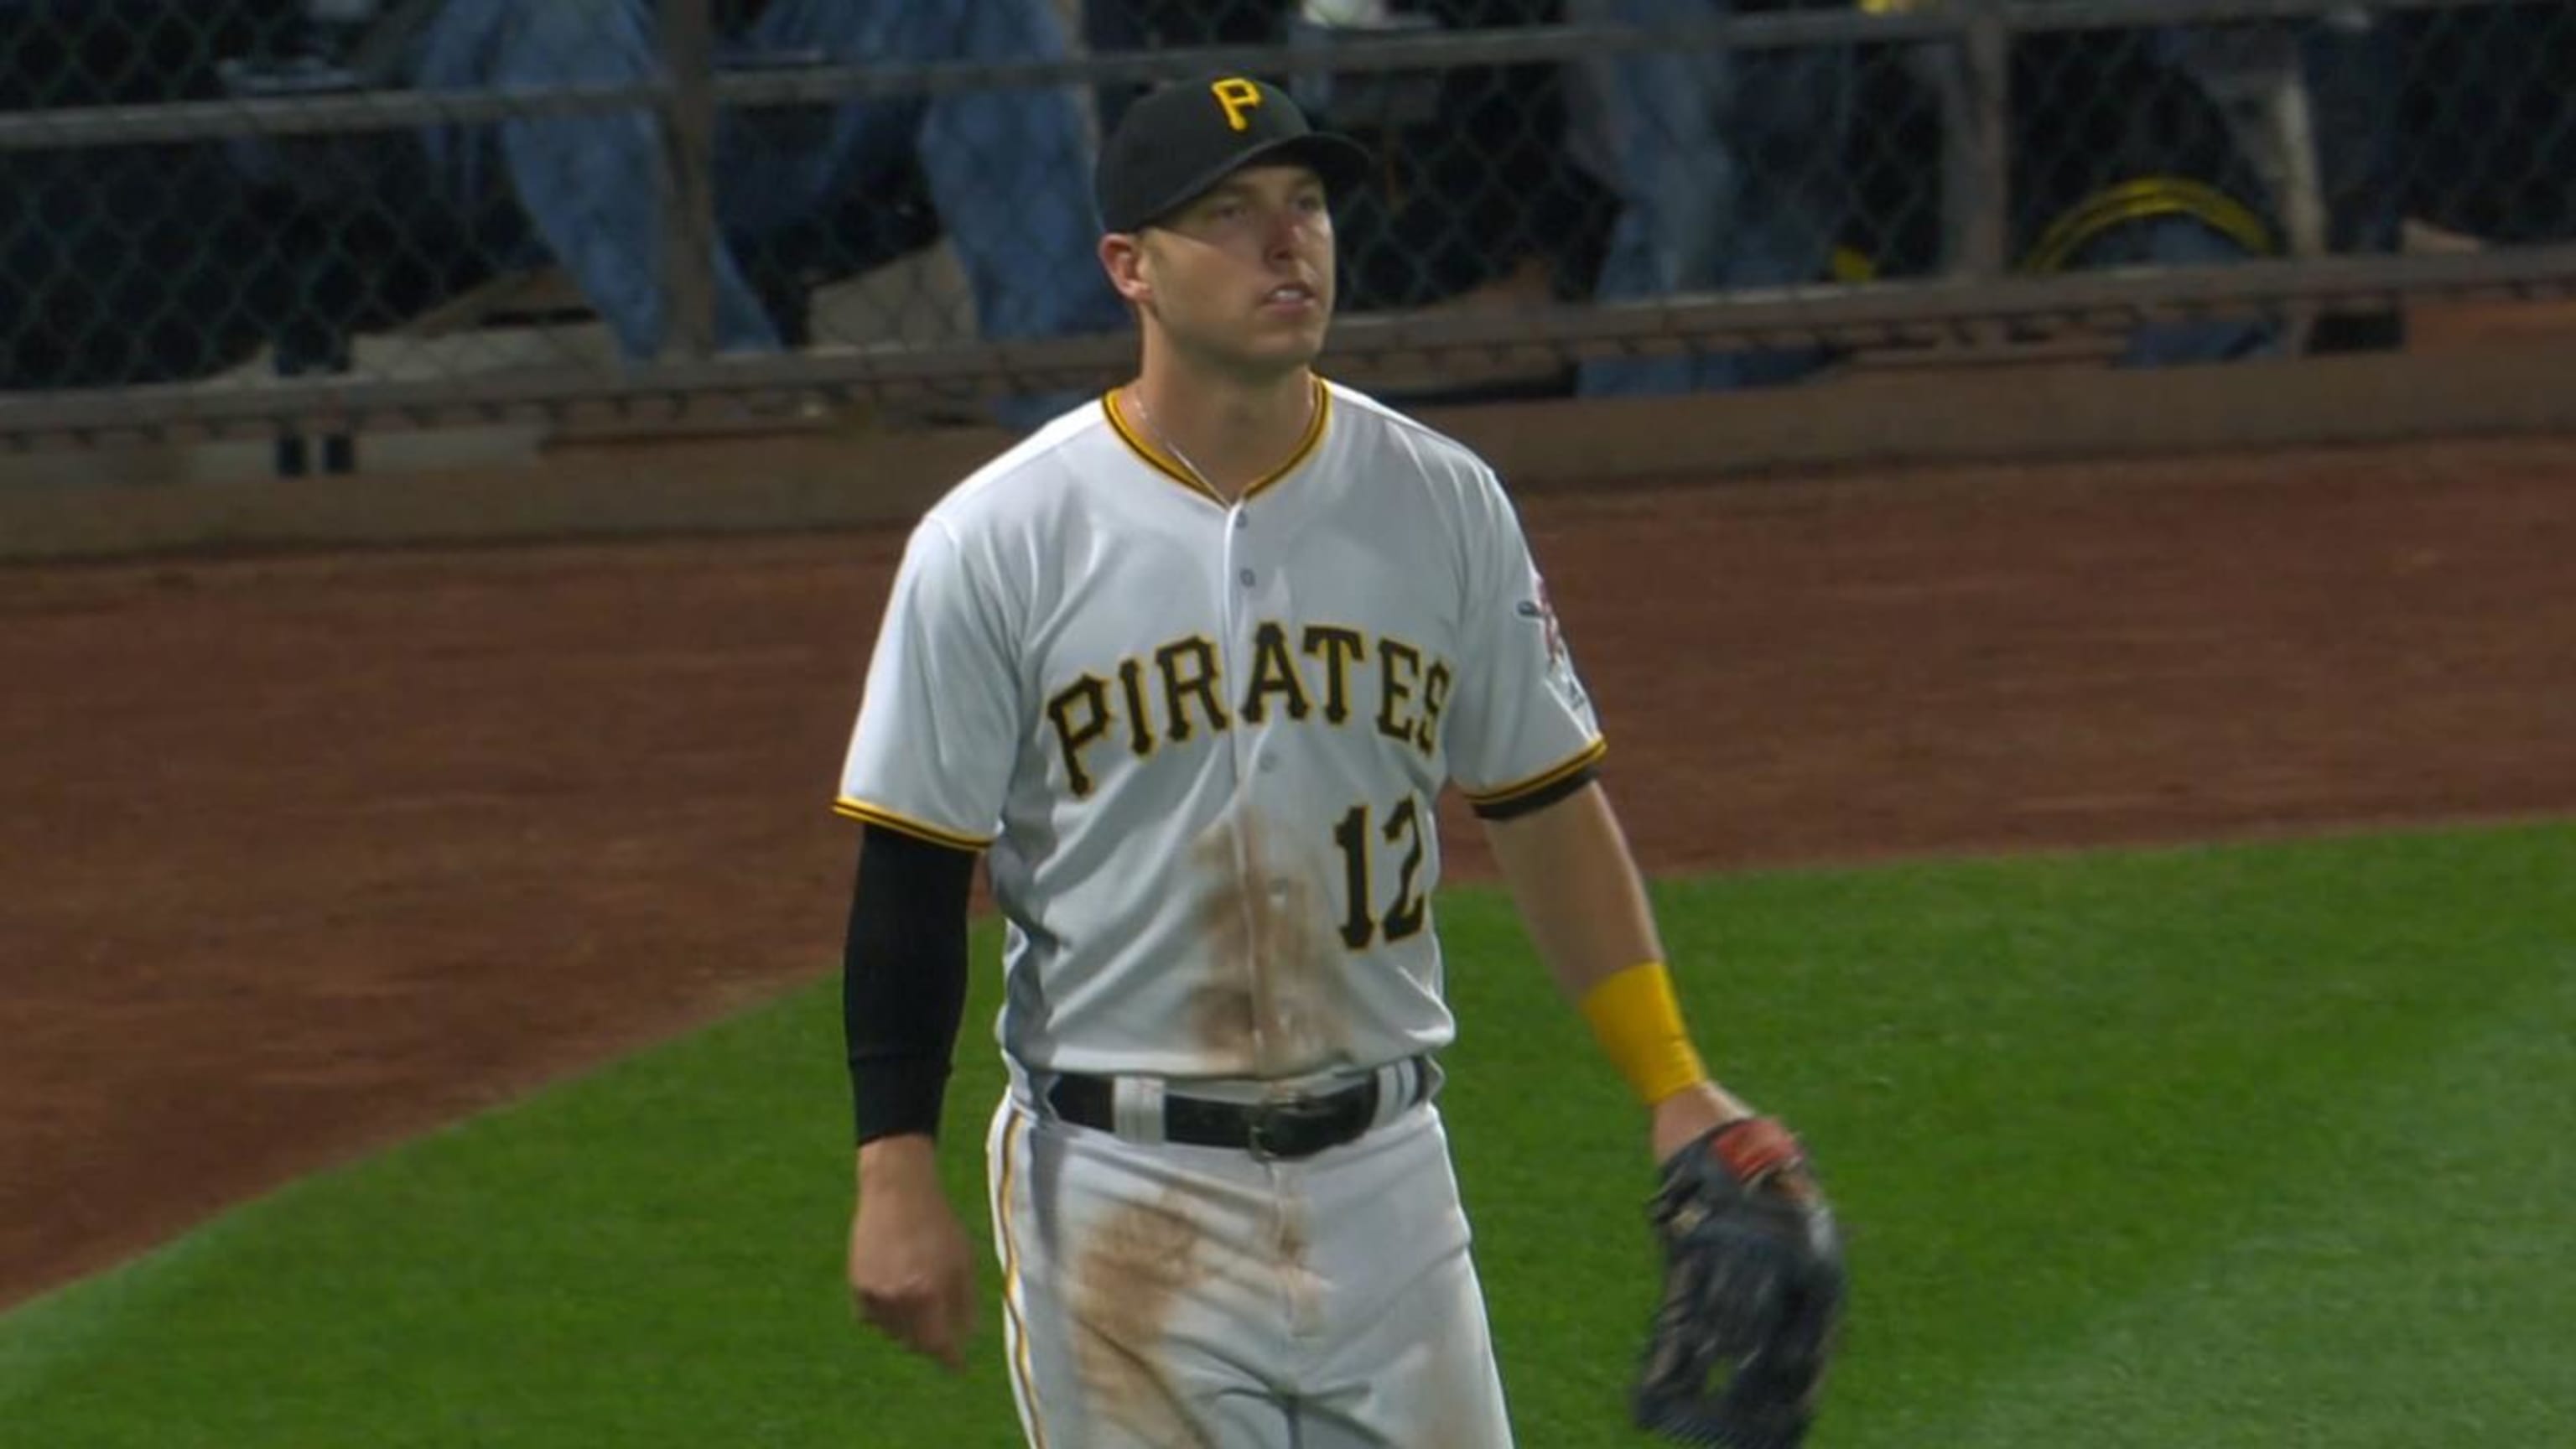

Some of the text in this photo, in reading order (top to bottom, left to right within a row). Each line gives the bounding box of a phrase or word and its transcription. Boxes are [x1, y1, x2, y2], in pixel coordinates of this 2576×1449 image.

[1212, 77, 1260, 131] P
[1046, 621, 1453, 799] PIRATES
[1334, 794, 1425, 951] 12
